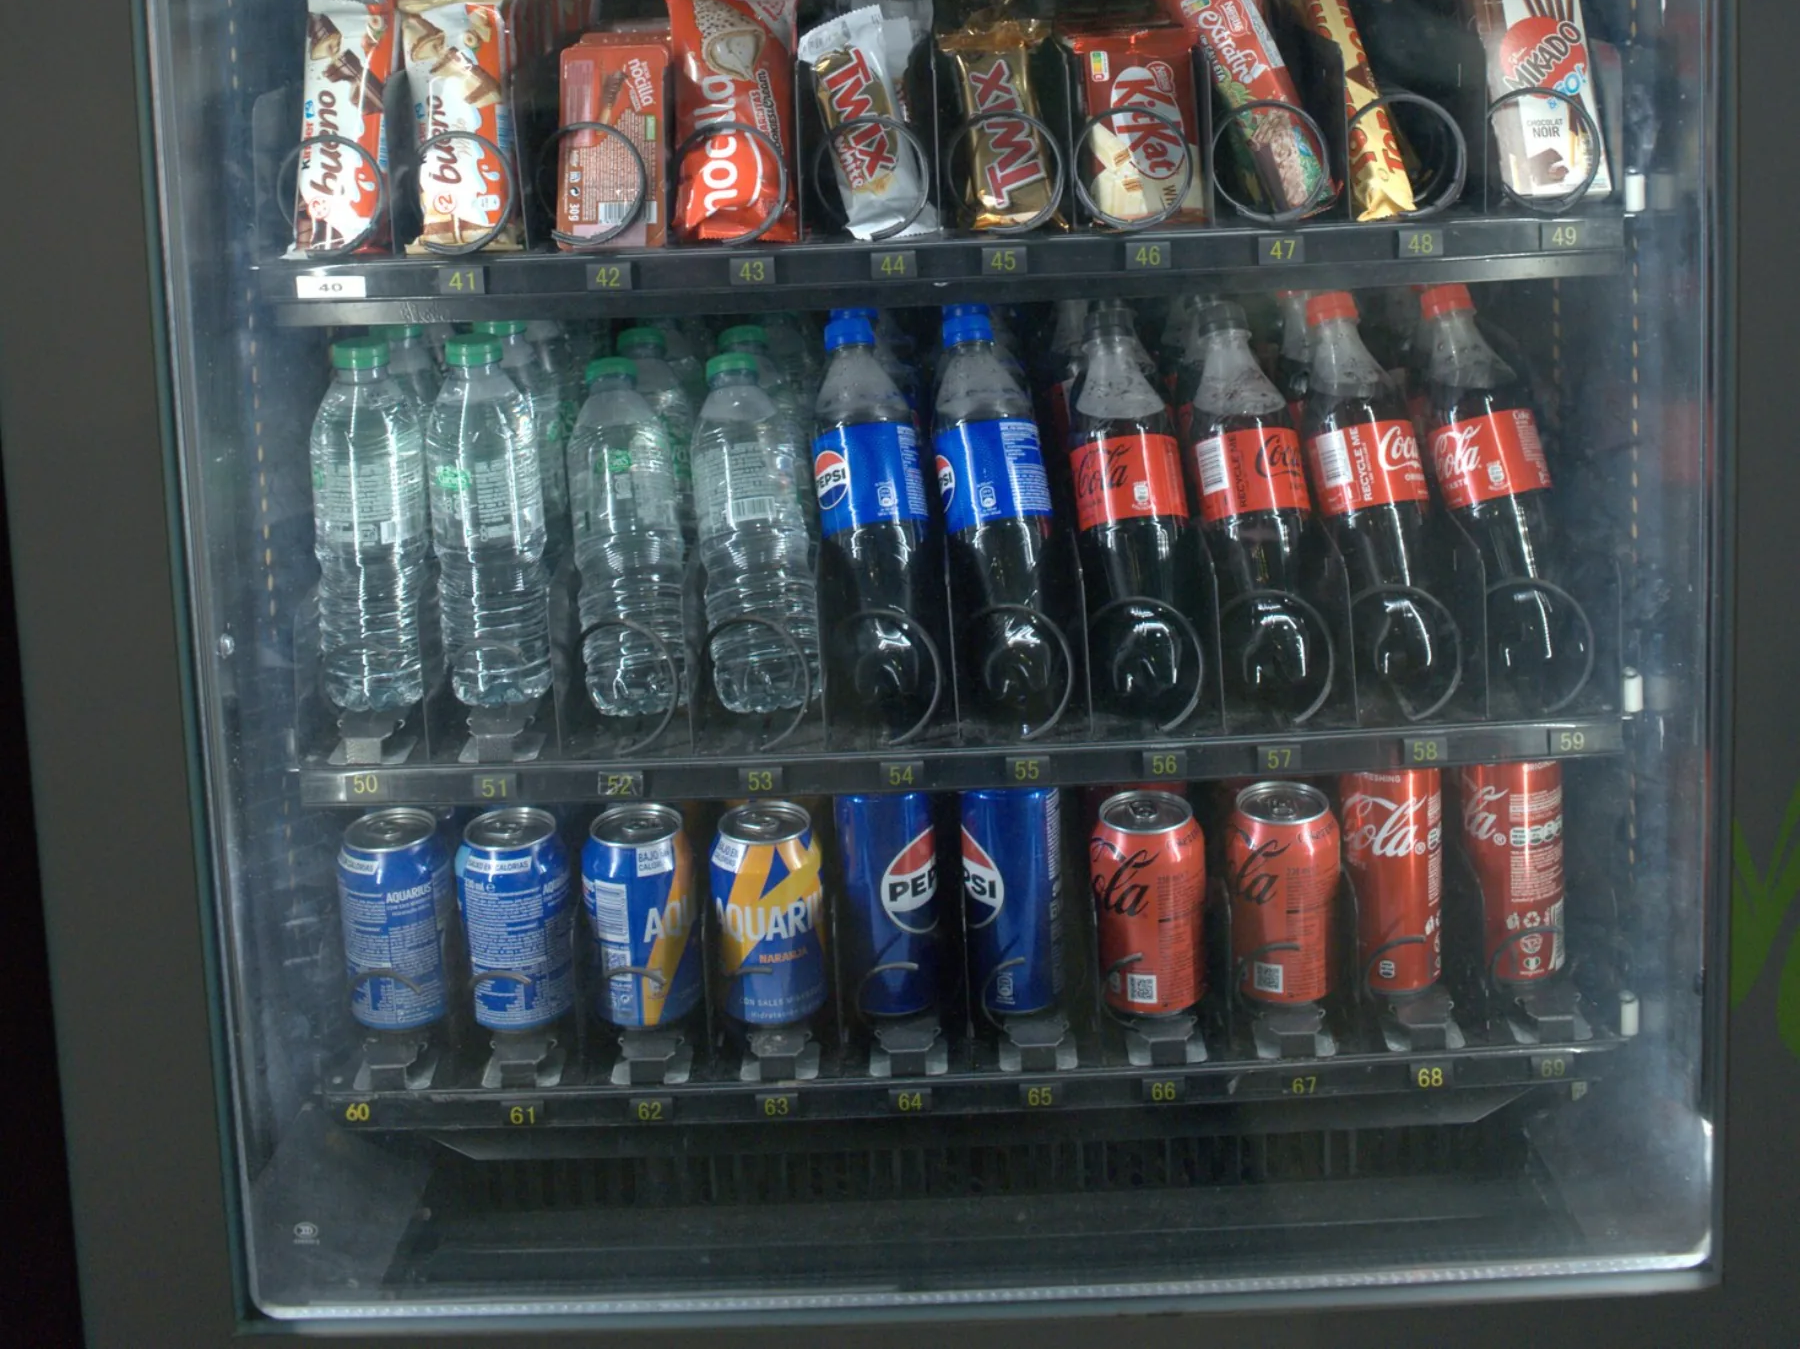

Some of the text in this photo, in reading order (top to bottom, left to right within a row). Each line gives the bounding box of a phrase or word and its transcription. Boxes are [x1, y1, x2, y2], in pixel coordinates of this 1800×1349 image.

[1504, 20, 1582, 93] MIKADO
[627, 57, 656, 107] nocilla
[824, 48, 898, 184] TWIX
[1526, 118, 1563, 127] CHOCOLAT
[969, 58, 1048, 209] TWIX
[1112, 78, 1185, 177] KitKat
[1532, 126, 1561, 138] NOIR
[301, 89, 343, 195] kiner bueno
[695, 74, 738, 217] nocilla
[567, 200, 581, 222] 30g
[1408, 234, 1433, 254] 48
[1552, 228, 1577, 246] 49
[1136, 245, 1161, 265] 46
[1270, 240, 1296, 259] 47
[881, 255, 905, 274] 44
[991, 252, 1016, 270] 45
[449, 272, 474, 290] 41
[596, 268, 621, 287] 42
[740, 262, 765, 281] 43
[318, 283, 343, 292] 40
[1378, 424, 1422, 470] Coca
[1348, 427, 1374, 501] RECYCLE ME
[1413, 741, 1438, 760] 58
[1560, 732, 1585, 751] 59
[1152, 755, 1177, 774] 56
[1267, 749, 1291, 769] 57
[889, 766, 914, 786] 54
[1014, 761, 1040, 781] 55
[353, 774, 378, 794] 50
[481, 776, 507, 797] 51
[606, 775, 631, 795] 52
[748, 771, 773, 791] 53
[386, 880, 432, 903] AQUARIUS
[715, 887, 824, 944] AQUARI
[1541, 1058, 1566, 1077] 69
[1291, 1076, 1317, 1094] 67
[1416, 1067, 1444, 1088] 68
[1027, 1087, 1053, 1106] 65
[1151, 1082, 1176, 1101] 66
[764, 1097, 789, 1116] 63
[898, 1092, 922, 1111] 64
[345, 1103, 370, 1122] 60
[510, 1106, 537, 1125] 61
[638, 1102, 663, 1121] 62
